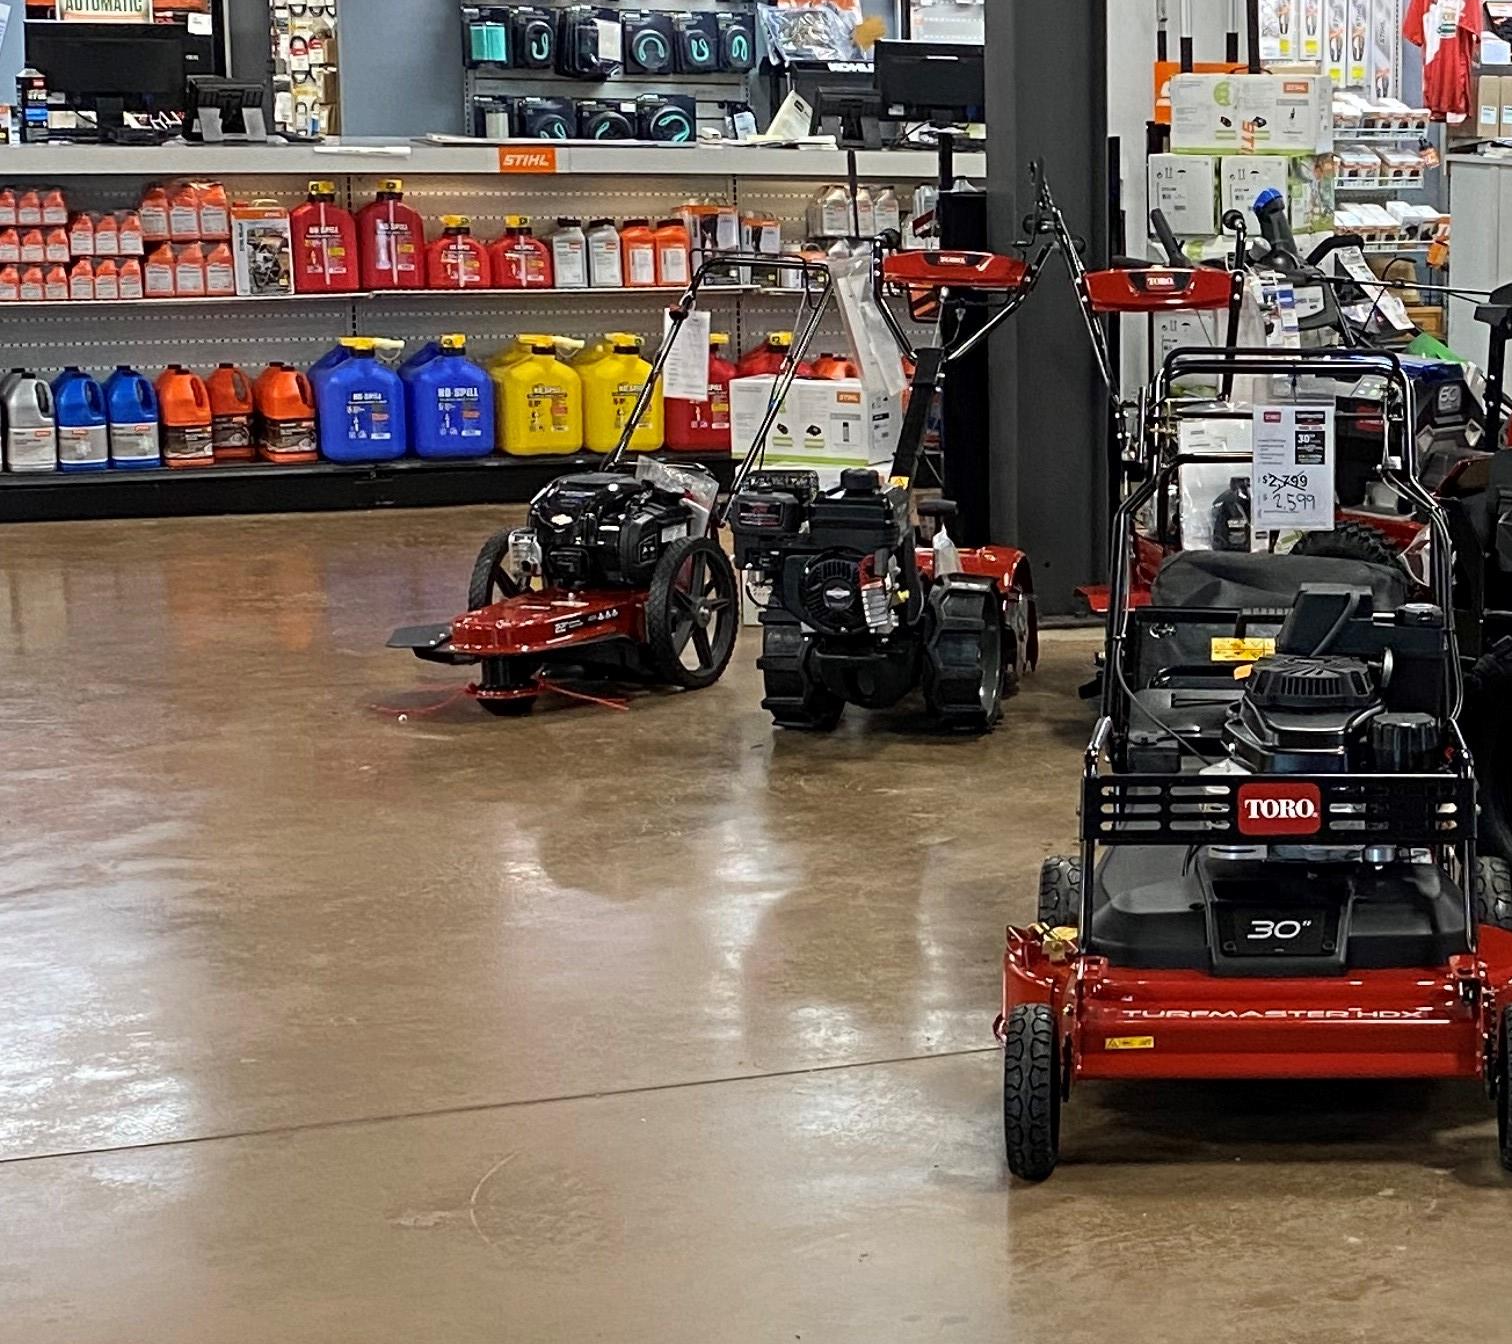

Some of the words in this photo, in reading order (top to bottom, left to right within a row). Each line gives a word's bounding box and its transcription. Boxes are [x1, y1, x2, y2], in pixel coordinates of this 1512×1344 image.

[501, 152, 550, 168] STIHL
[1244, 797, 1318, 820] TORO
[1246, 919, 1312, 941] 30"
[1121, 1009, 1350, 1019] TURFMASTER
[1360, 1009, 1424, 1019] HDX
